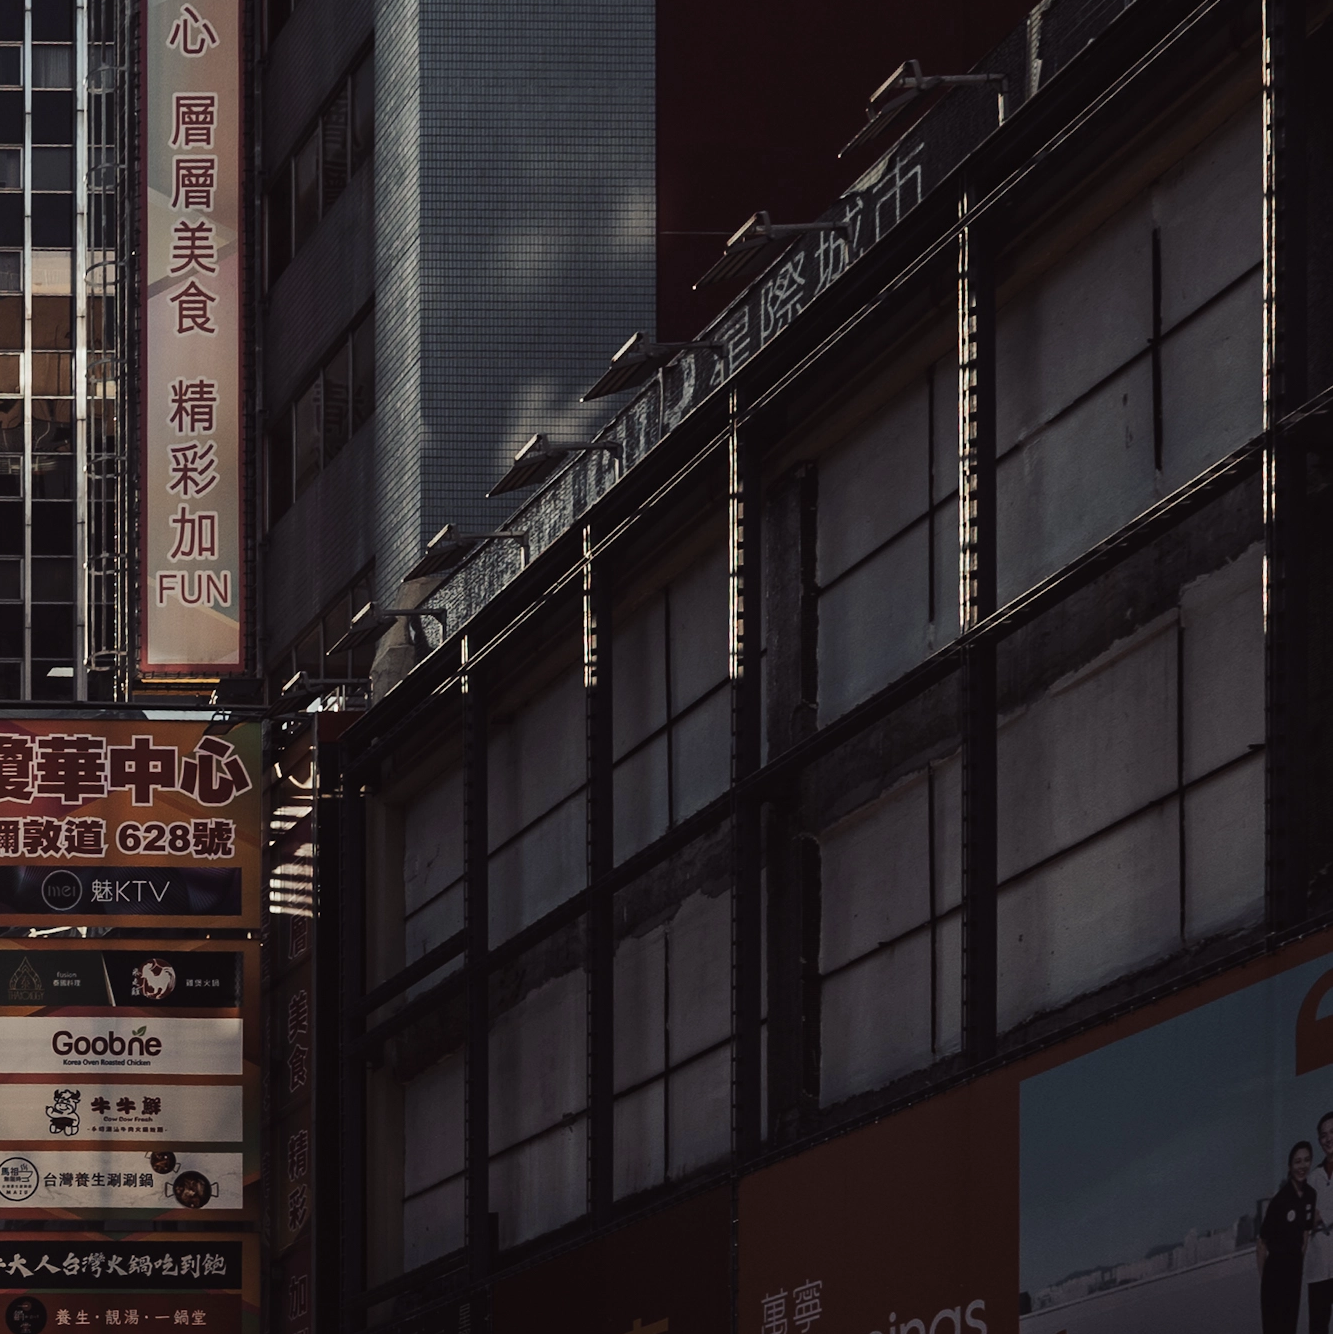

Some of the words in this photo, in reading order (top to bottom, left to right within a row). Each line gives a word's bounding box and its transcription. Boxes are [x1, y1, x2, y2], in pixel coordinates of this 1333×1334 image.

[168, 92, 218, 336] 層層美食
[168, 378, 218, 560] 精彩加
[156, 572, 231, 607] FUN
[116, 818, 235, 859] 628號
[47, 884, 76, 897] mei
[91, 879, 170, 902] 魅KTV
[52, 1029, 162, 1056] Goobne
[91, 1096, 161, 1115] 牛牛鮮
